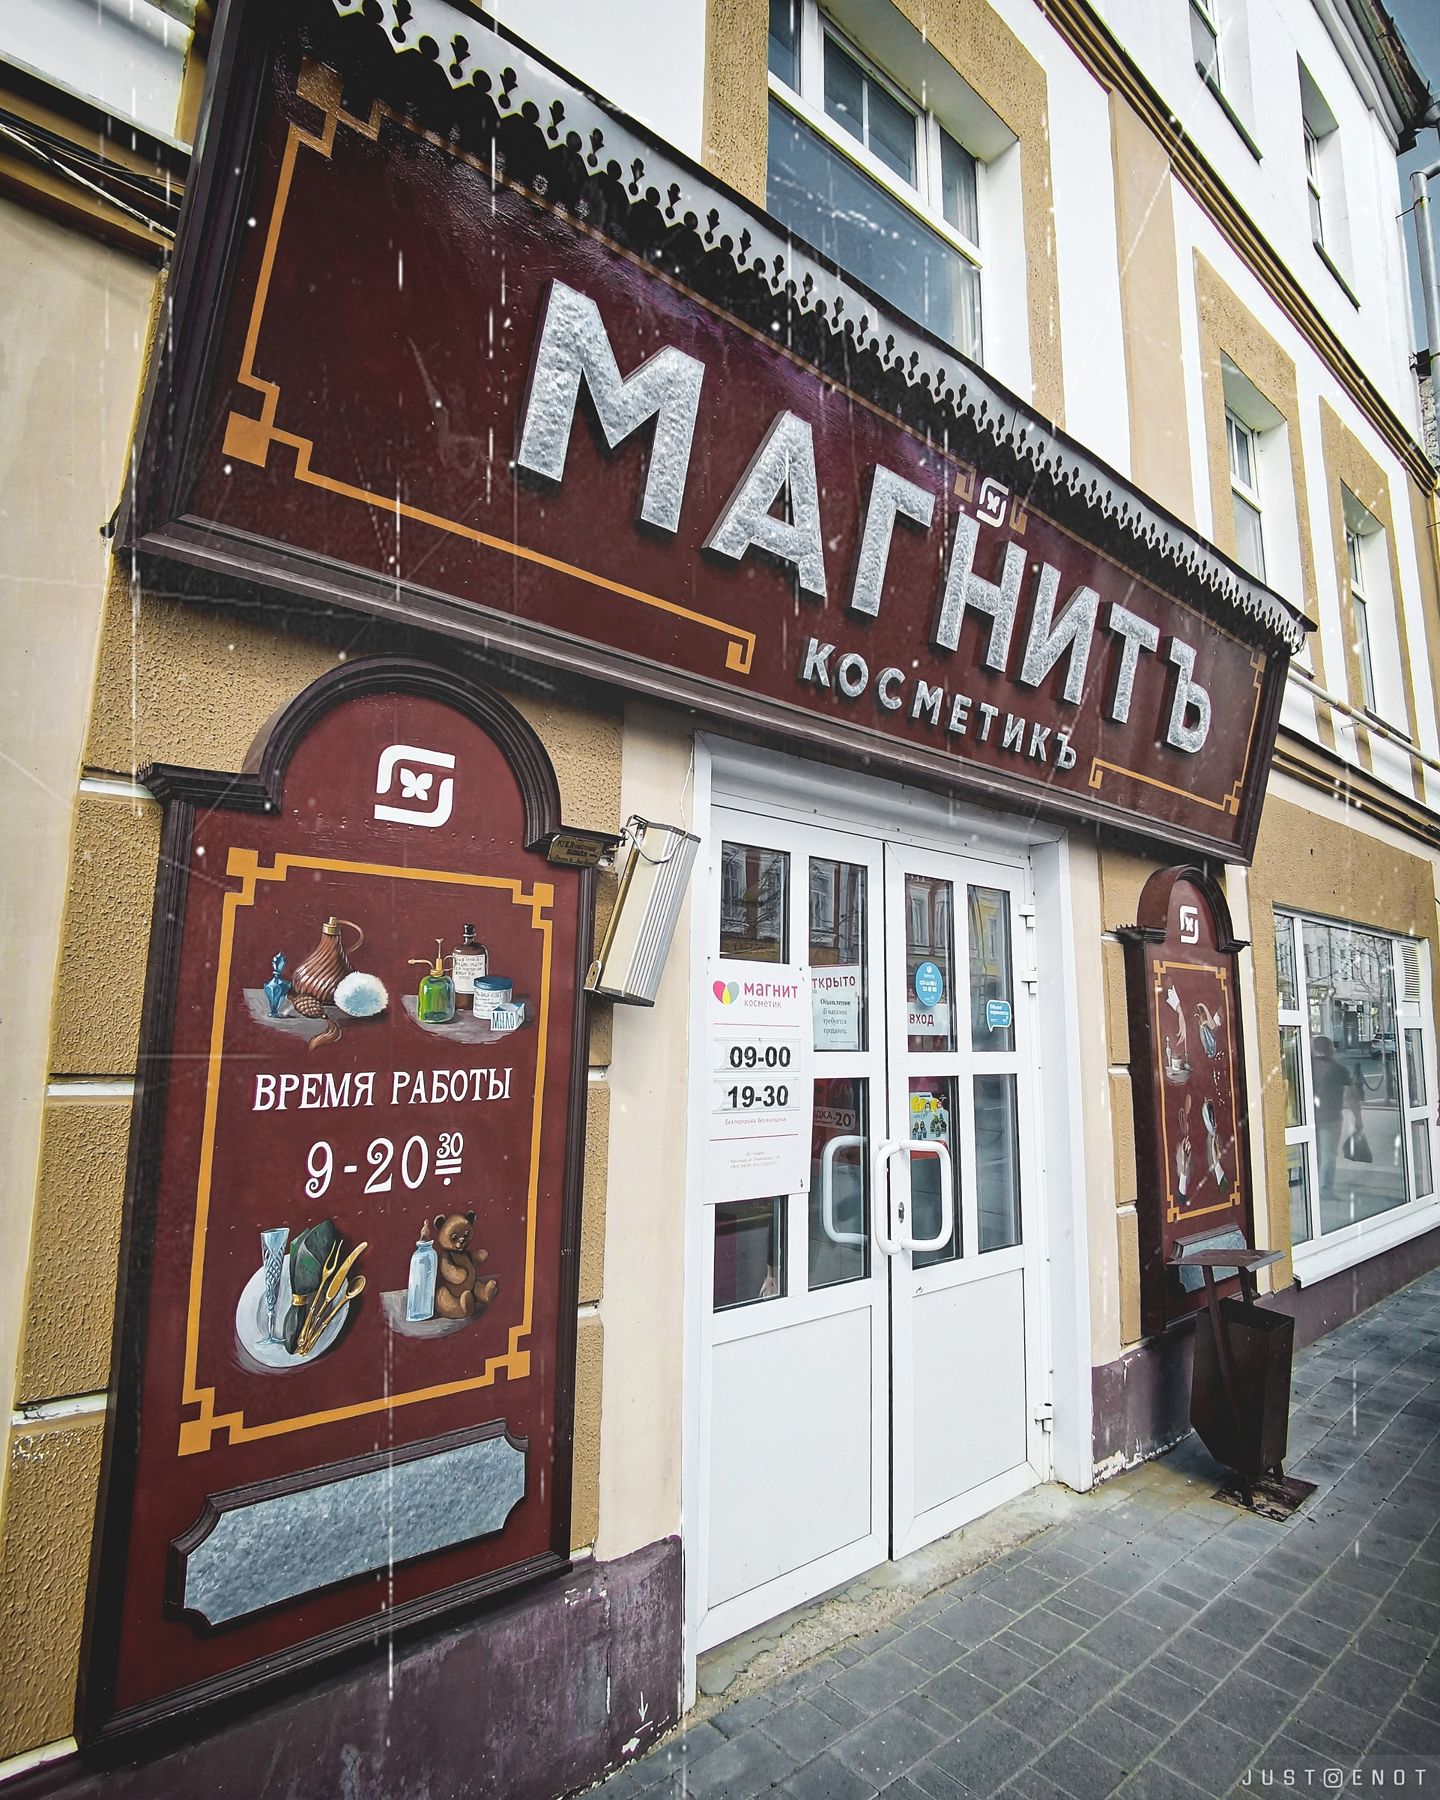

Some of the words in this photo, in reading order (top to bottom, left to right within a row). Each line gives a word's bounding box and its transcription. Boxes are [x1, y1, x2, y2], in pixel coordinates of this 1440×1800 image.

[516, 277, 1212, 754] МАГНИТЪ
[802, 636, 1078, 771] КОСМЕТИКЪ
[811, 975, 856, 990] ткрыто
[492, 1012, 516, 1030] МЫЛО
[729, 1045, 791, 1068] 09-00
[252, 1071, 376, 1112] ВРЕМЯ
[390, 1067, 513, 1106] РАБОТЫ
[727, 1084, 789, 1109] 19-30
